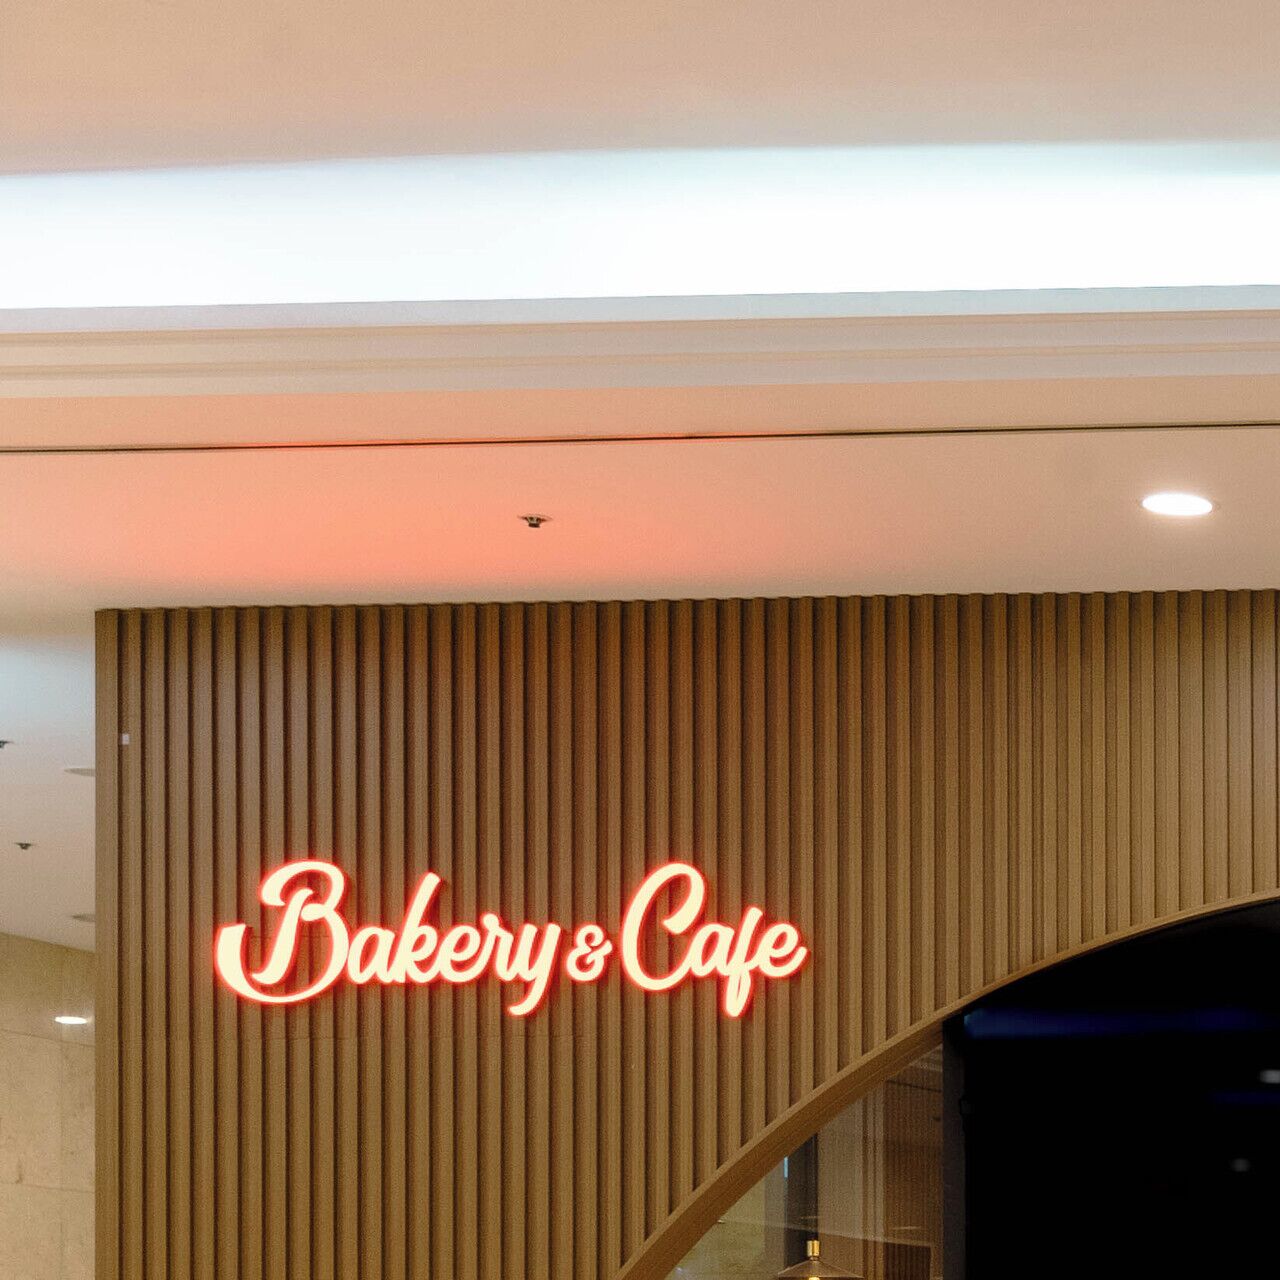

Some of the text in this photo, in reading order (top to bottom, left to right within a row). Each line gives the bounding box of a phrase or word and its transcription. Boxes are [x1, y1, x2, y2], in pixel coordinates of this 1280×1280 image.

[215, 860, 808, 1018] Bakery & Cafe
